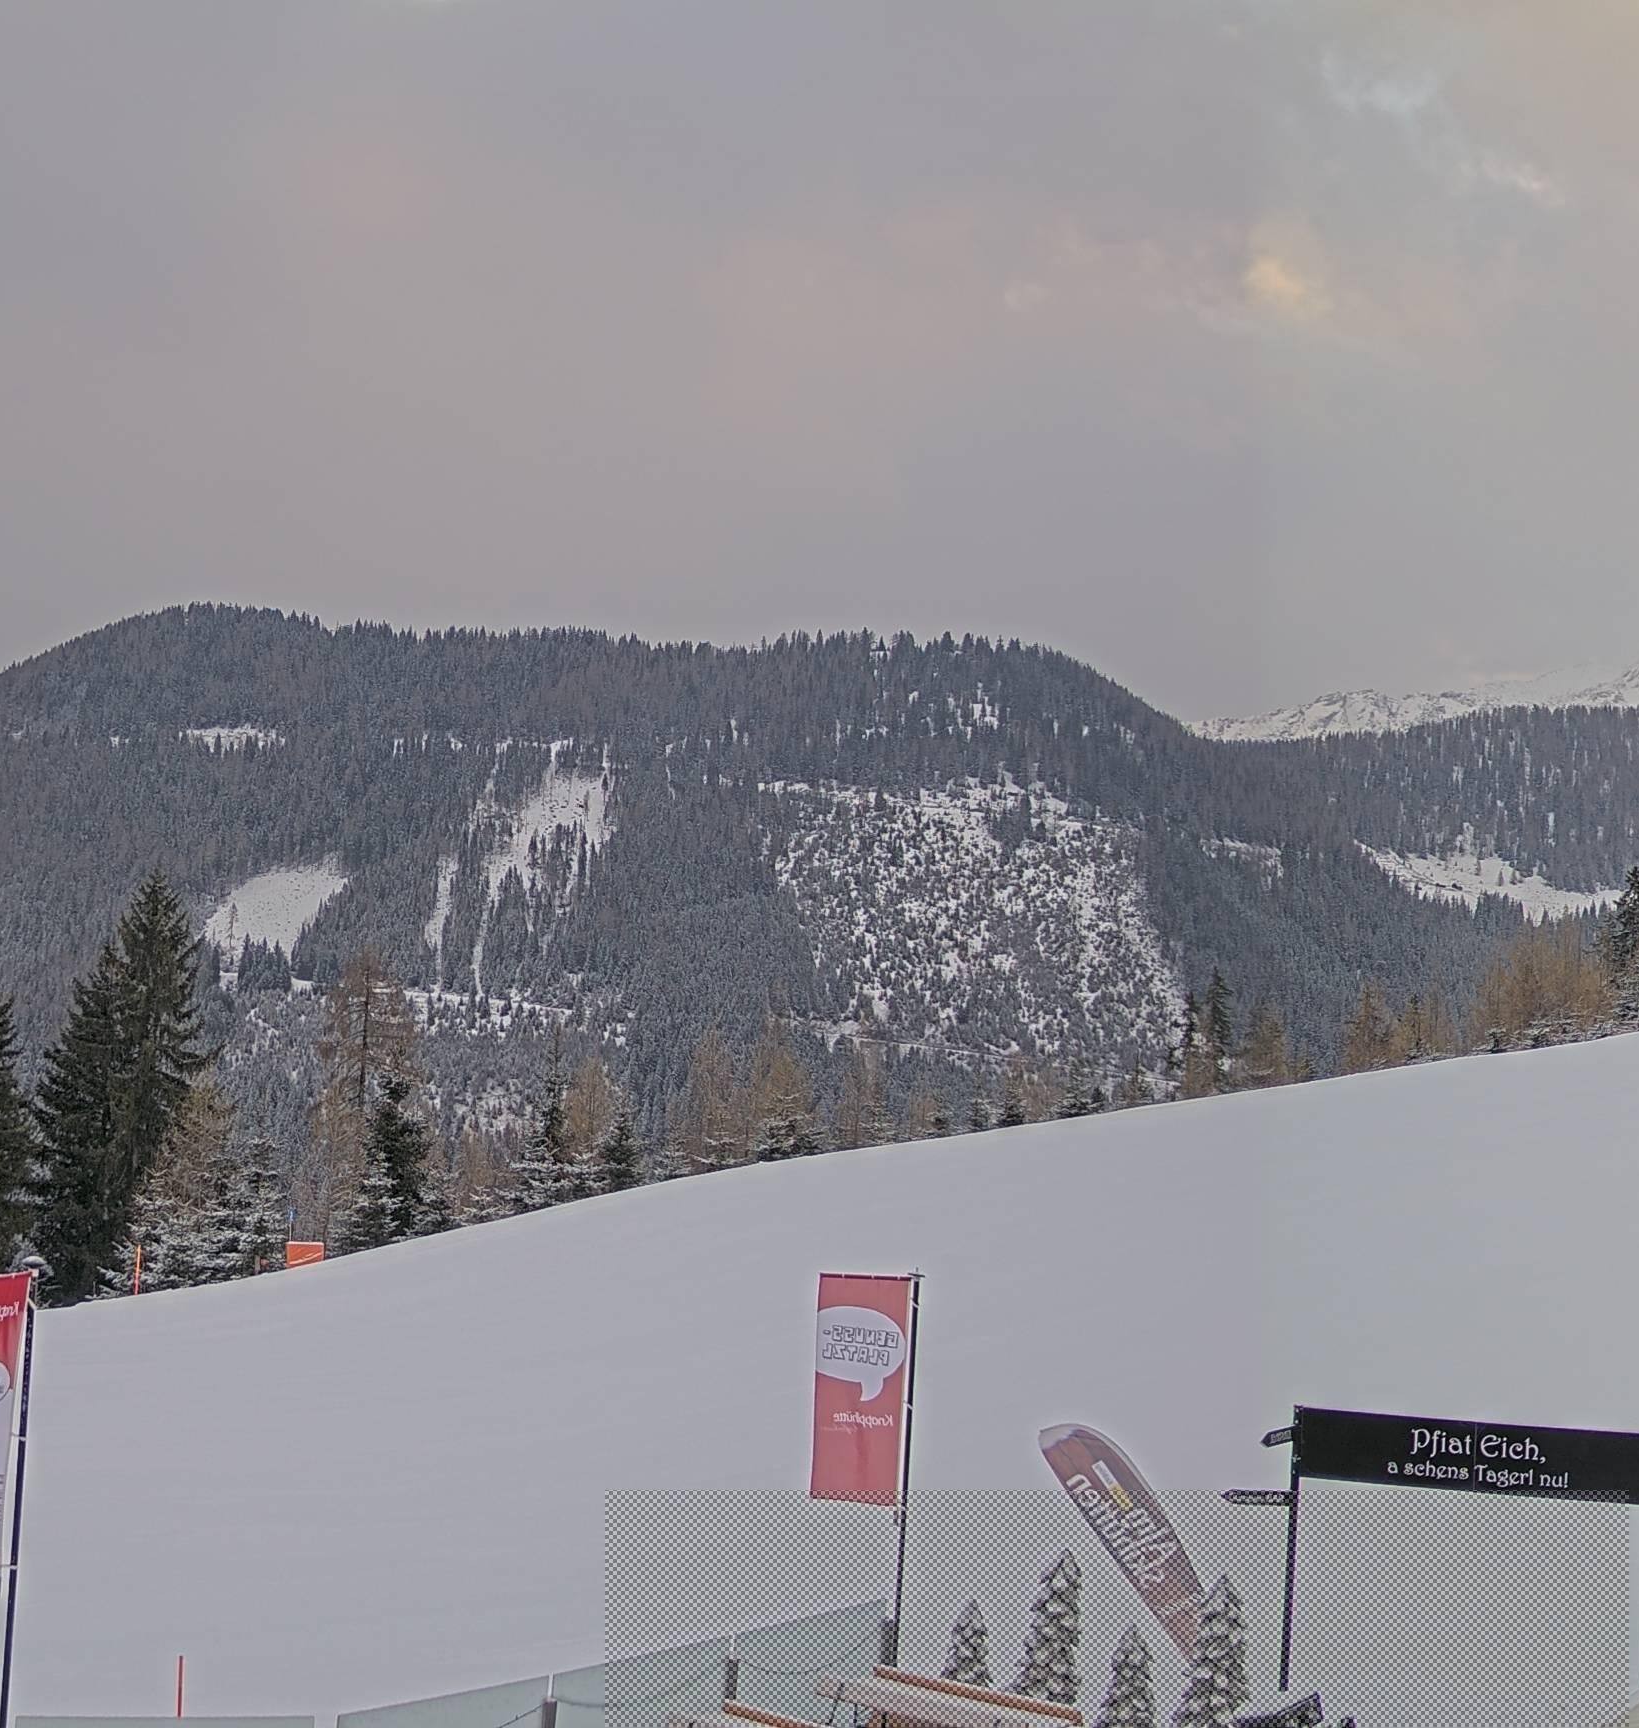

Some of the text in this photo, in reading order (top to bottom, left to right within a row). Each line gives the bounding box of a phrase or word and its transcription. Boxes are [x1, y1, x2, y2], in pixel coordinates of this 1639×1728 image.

[1410, 1427, 1547, 1464] Pfiat Eich,
[1387, 1460, 1570, 1489] a schens Tagerl nu!
